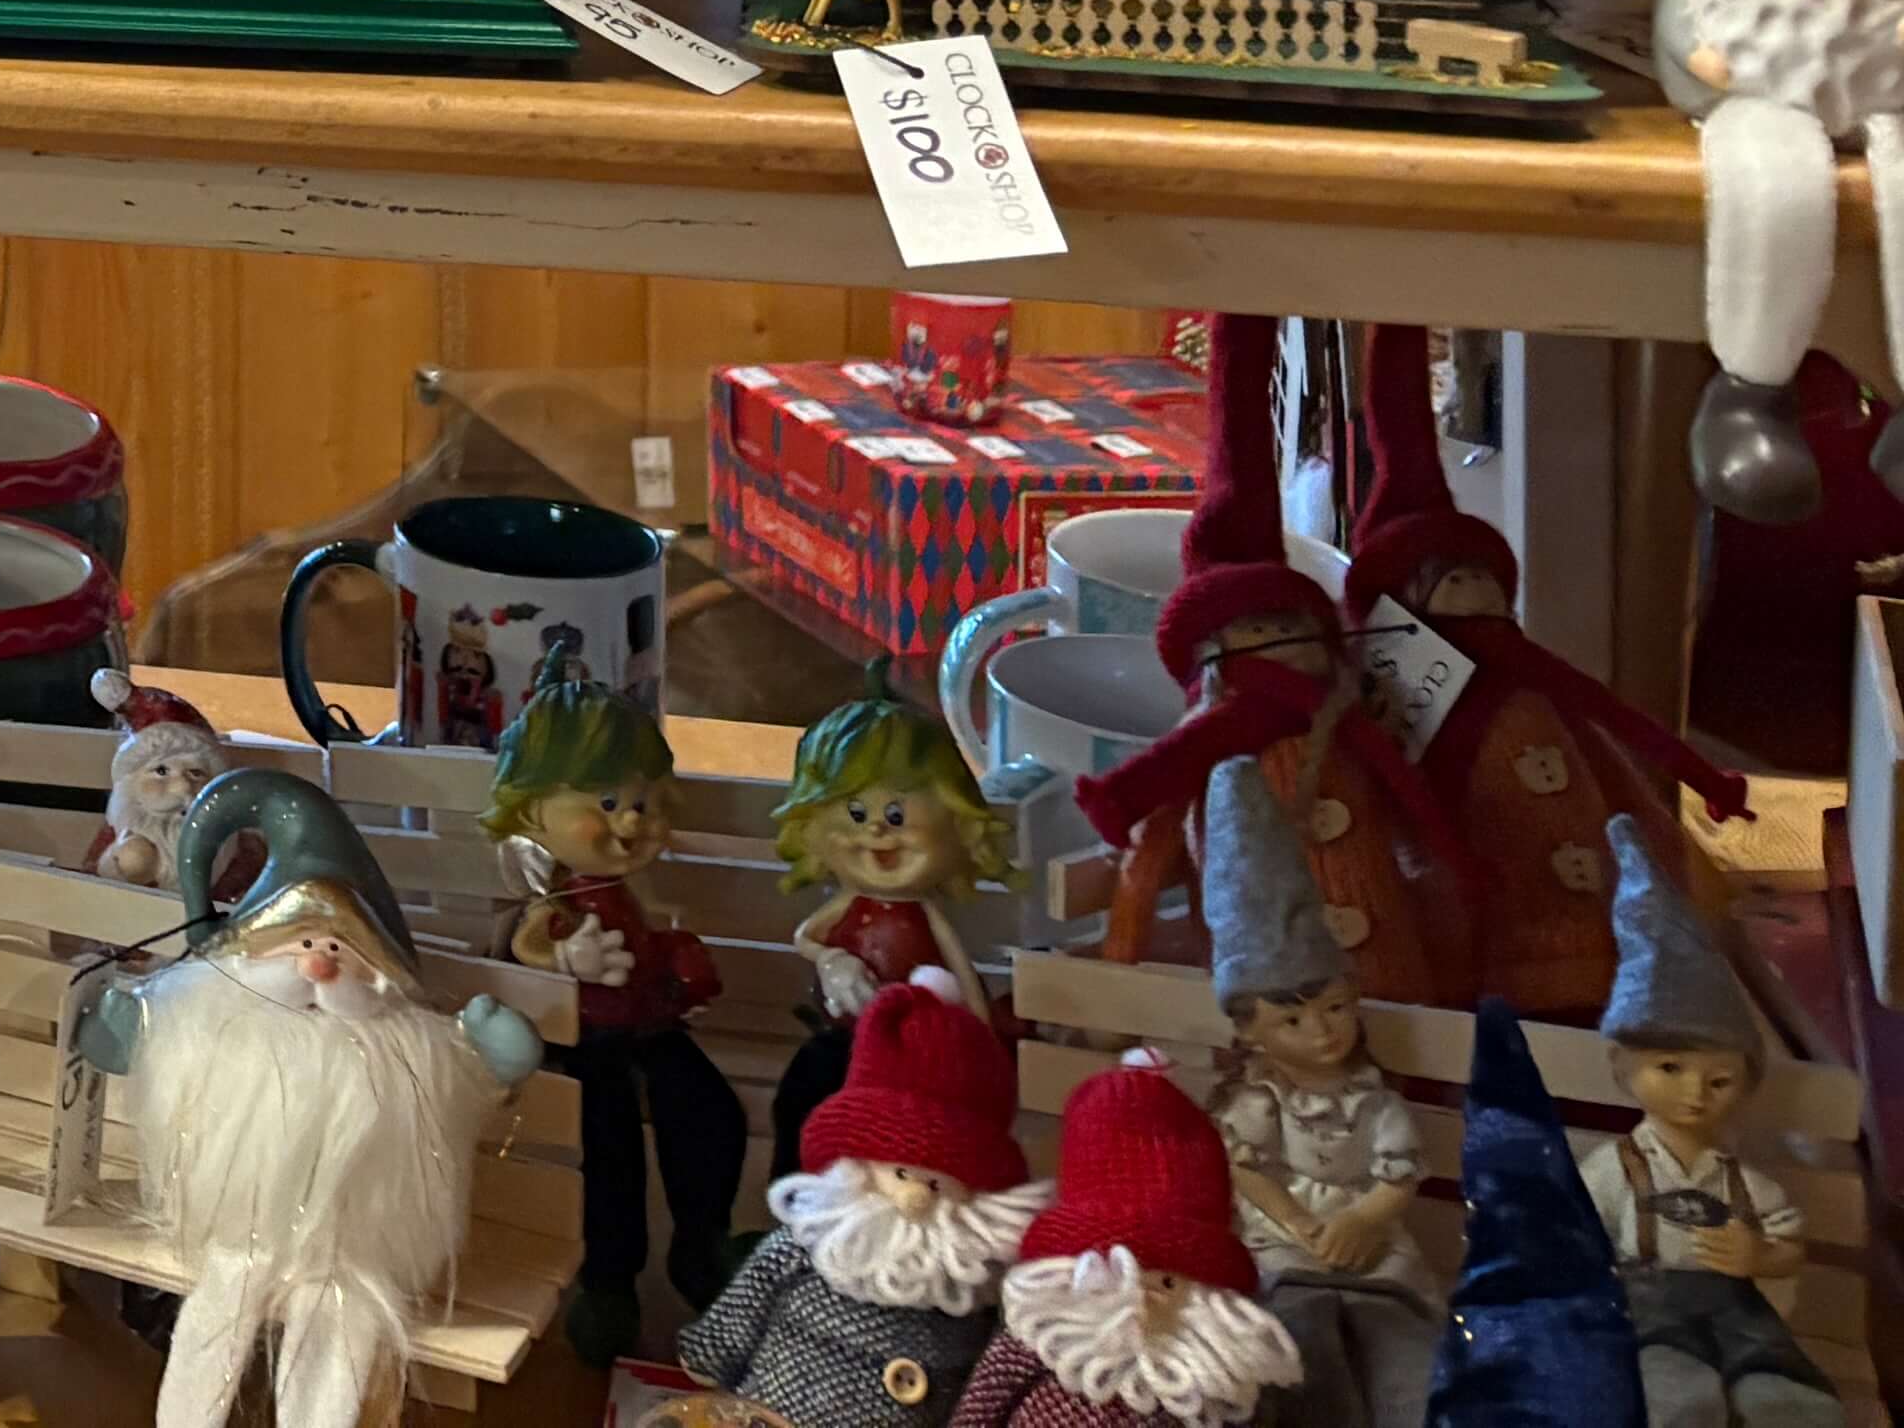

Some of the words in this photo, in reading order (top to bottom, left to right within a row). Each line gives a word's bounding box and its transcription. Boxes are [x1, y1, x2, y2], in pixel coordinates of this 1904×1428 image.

[879, 88, 956, 185] $100
[944, 51, 1000, 144] CLOCK
[984, 170, 1036, 237] SHOP
